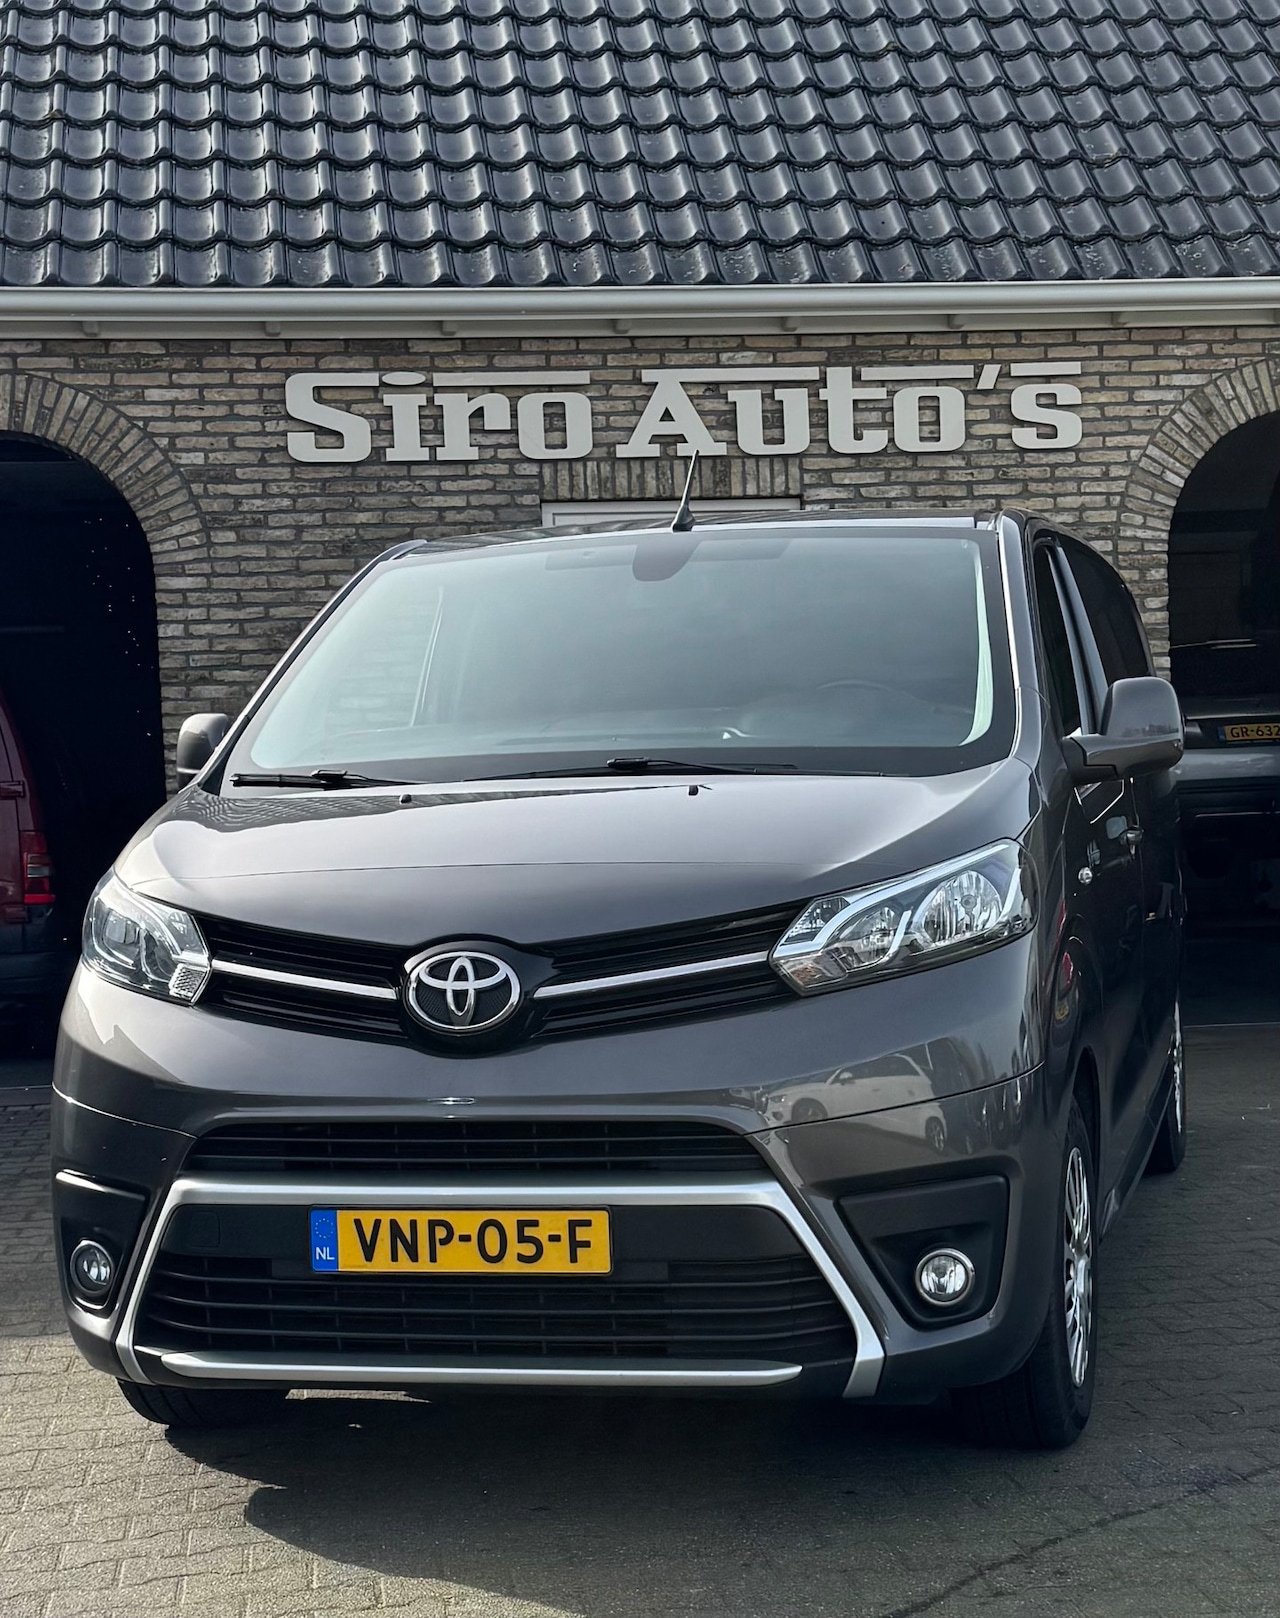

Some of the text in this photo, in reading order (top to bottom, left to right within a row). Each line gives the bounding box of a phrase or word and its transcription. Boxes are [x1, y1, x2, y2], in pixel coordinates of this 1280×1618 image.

[285, 361, 1082, 463] Siro Auto's
[316, 1246, 335, 1260] NL
[353, 1218, 593, 1264] VNP-05-F
